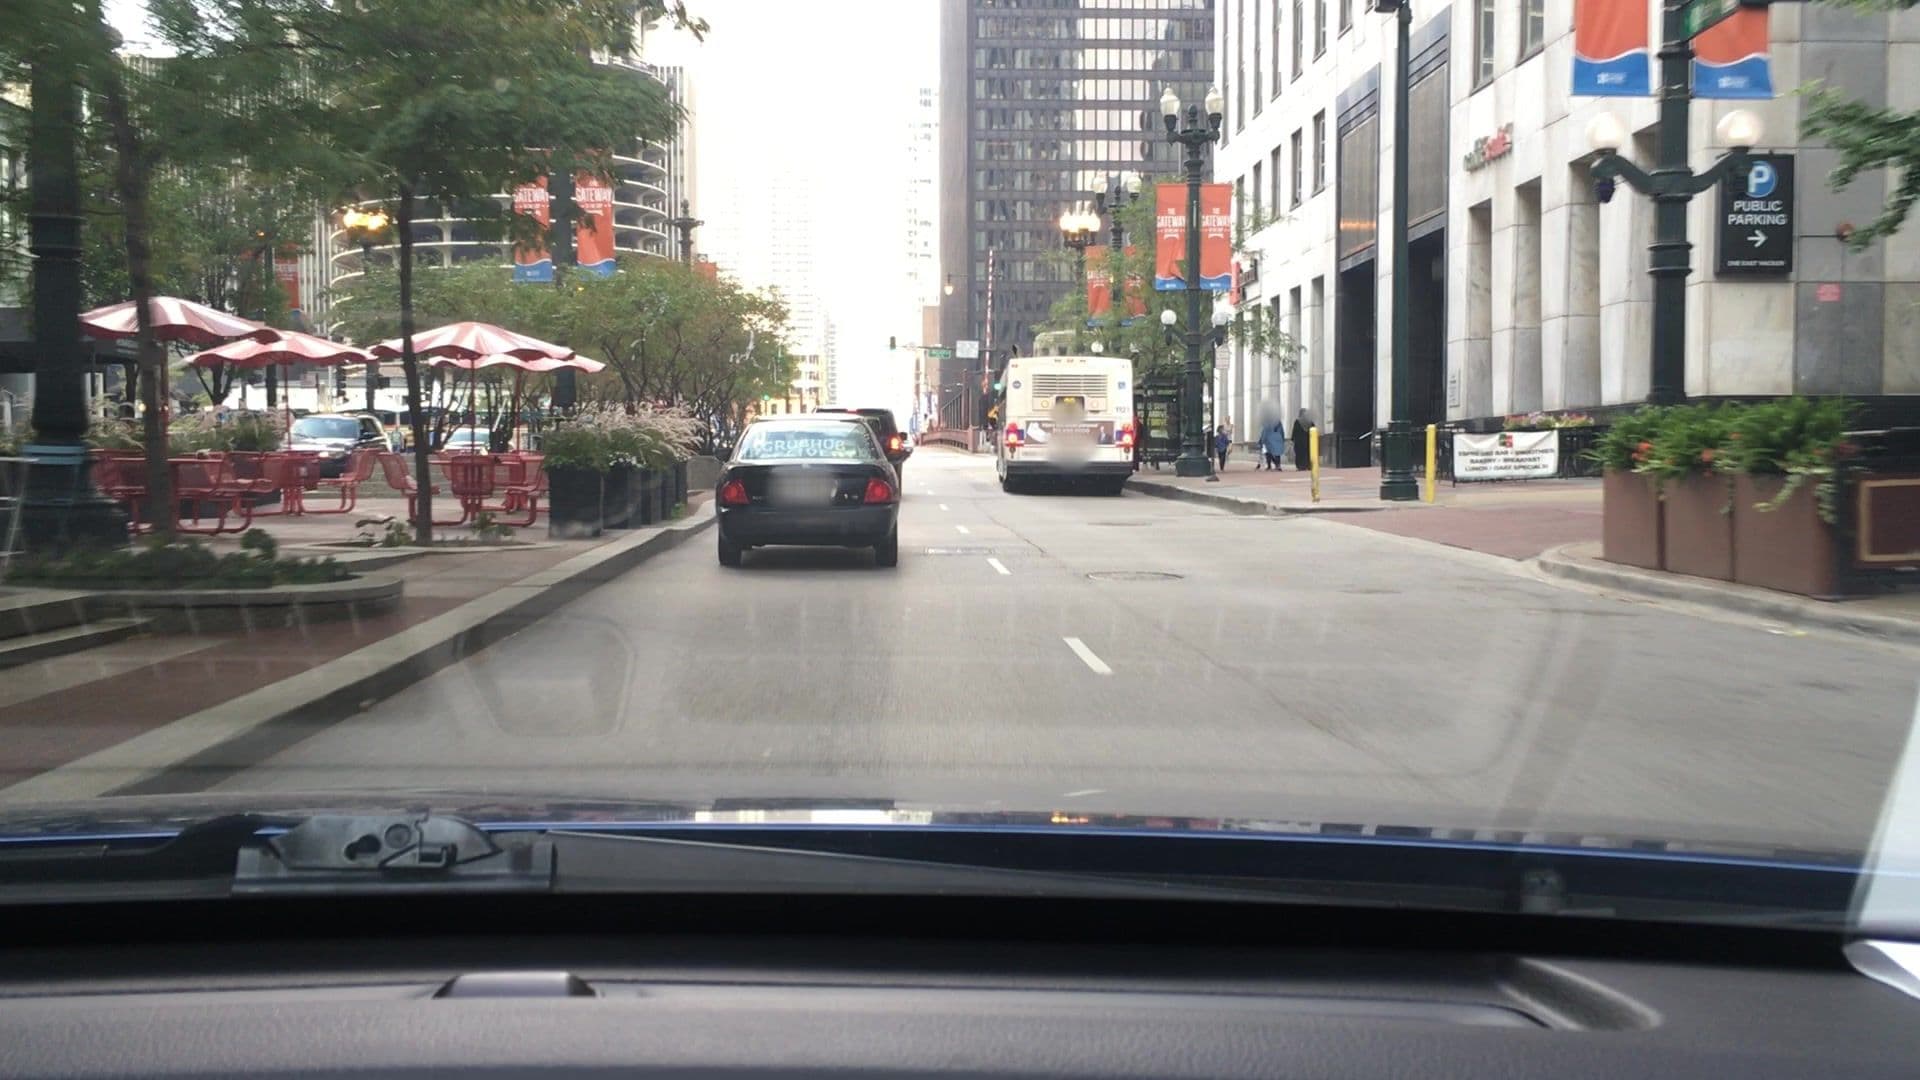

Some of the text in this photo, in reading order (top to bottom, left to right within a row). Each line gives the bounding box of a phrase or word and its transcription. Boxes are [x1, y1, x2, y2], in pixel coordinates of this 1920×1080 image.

[576, 187, 613, 202] GATEWAY
[1733, 200, 1782, 211] PUBLIC
[1156, 215, 1186, 228] GATEWAY
[1201, 215, 1231, 228] GATEWAY
[1728, 214, 1787, 225] PARKING
